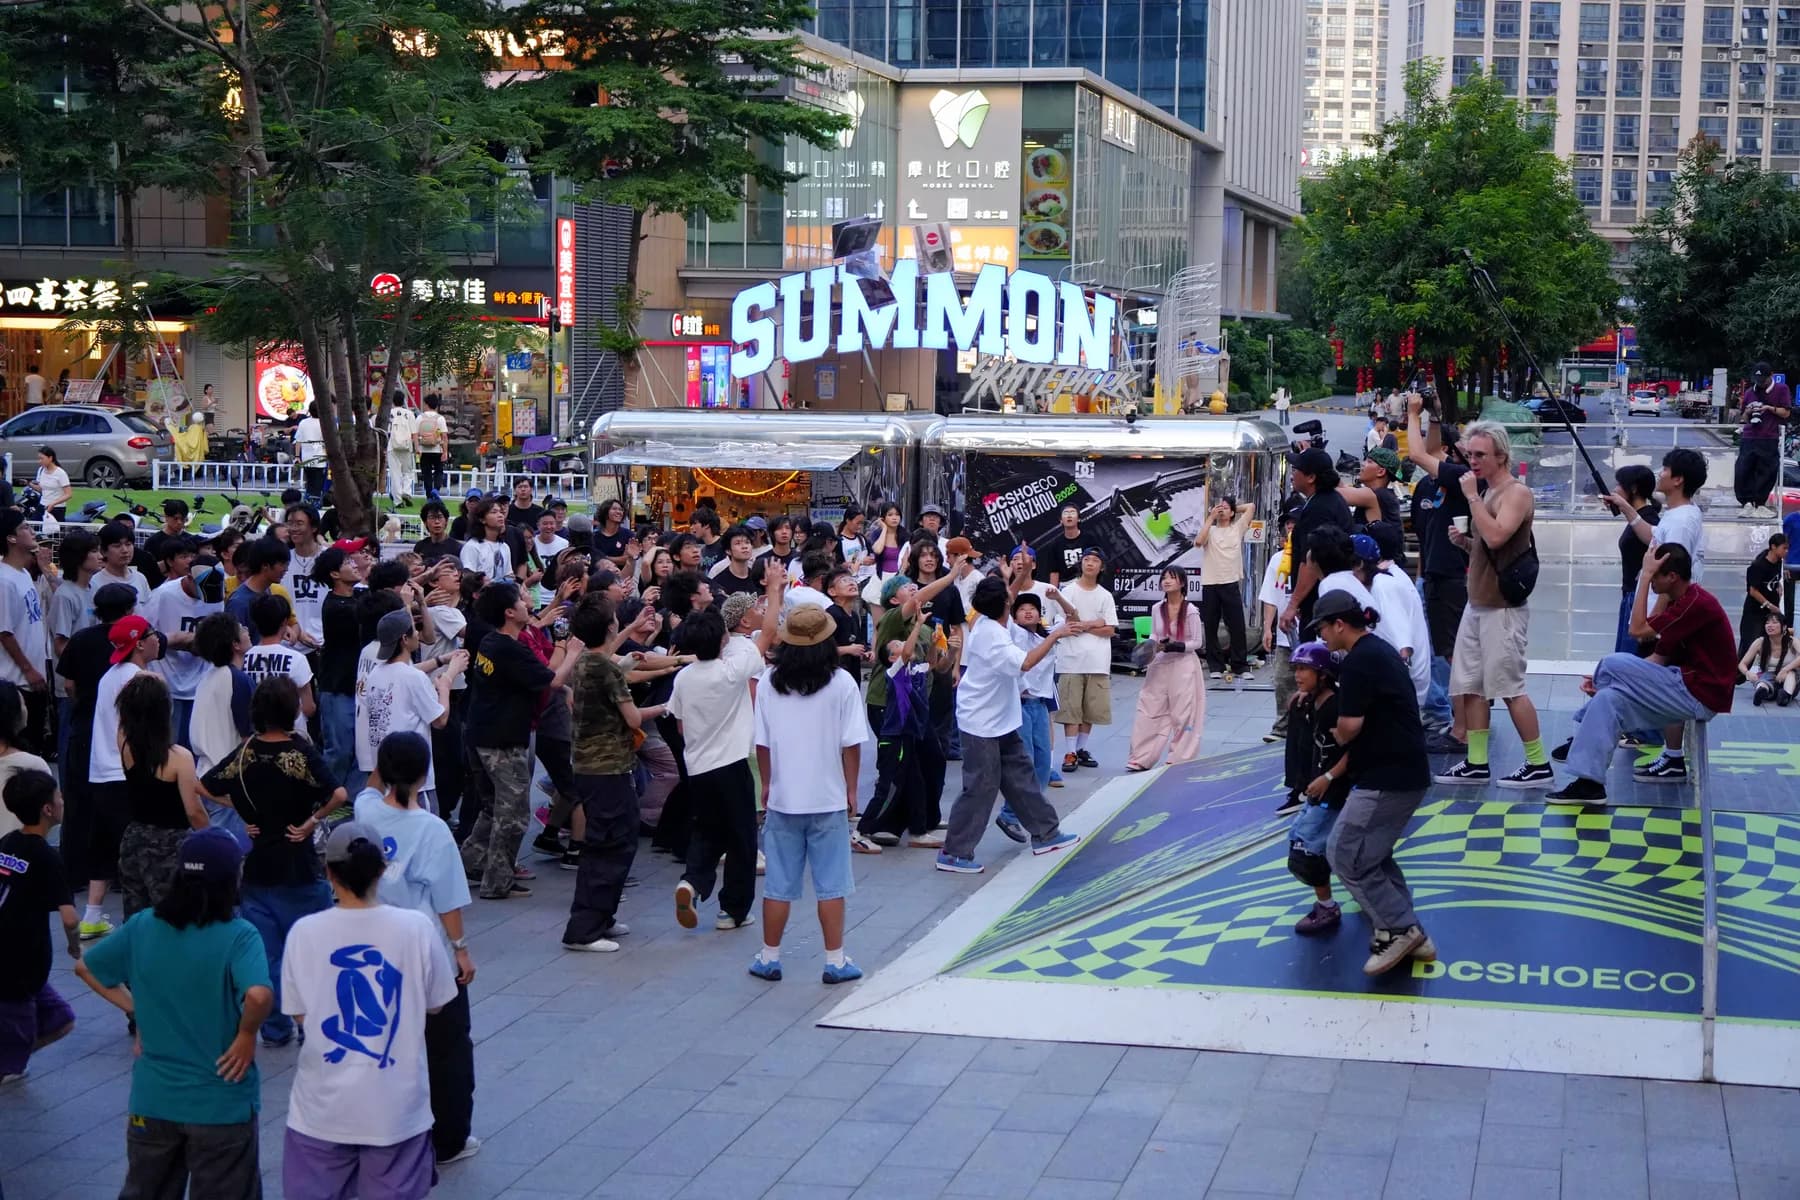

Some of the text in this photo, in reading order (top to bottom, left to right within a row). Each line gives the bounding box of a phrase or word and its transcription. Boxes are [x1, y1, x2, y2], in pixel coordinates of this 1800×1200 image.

[907, 160, 1010, 179] 摩比口腔
[559, 250, 574, 324] 美宜佳
[731, 257, 1117, 380] SUMMON
[961, 358, 1142, 405] SKATEPARK
[984, 475, 1058, 515] DCSHOECO
[989, 483, 1078, 535] GUANGZHOU 2026
[1114, 578, 1135, 591] 6/21
[1411, 959, 1697, 994] DCSHOECO
